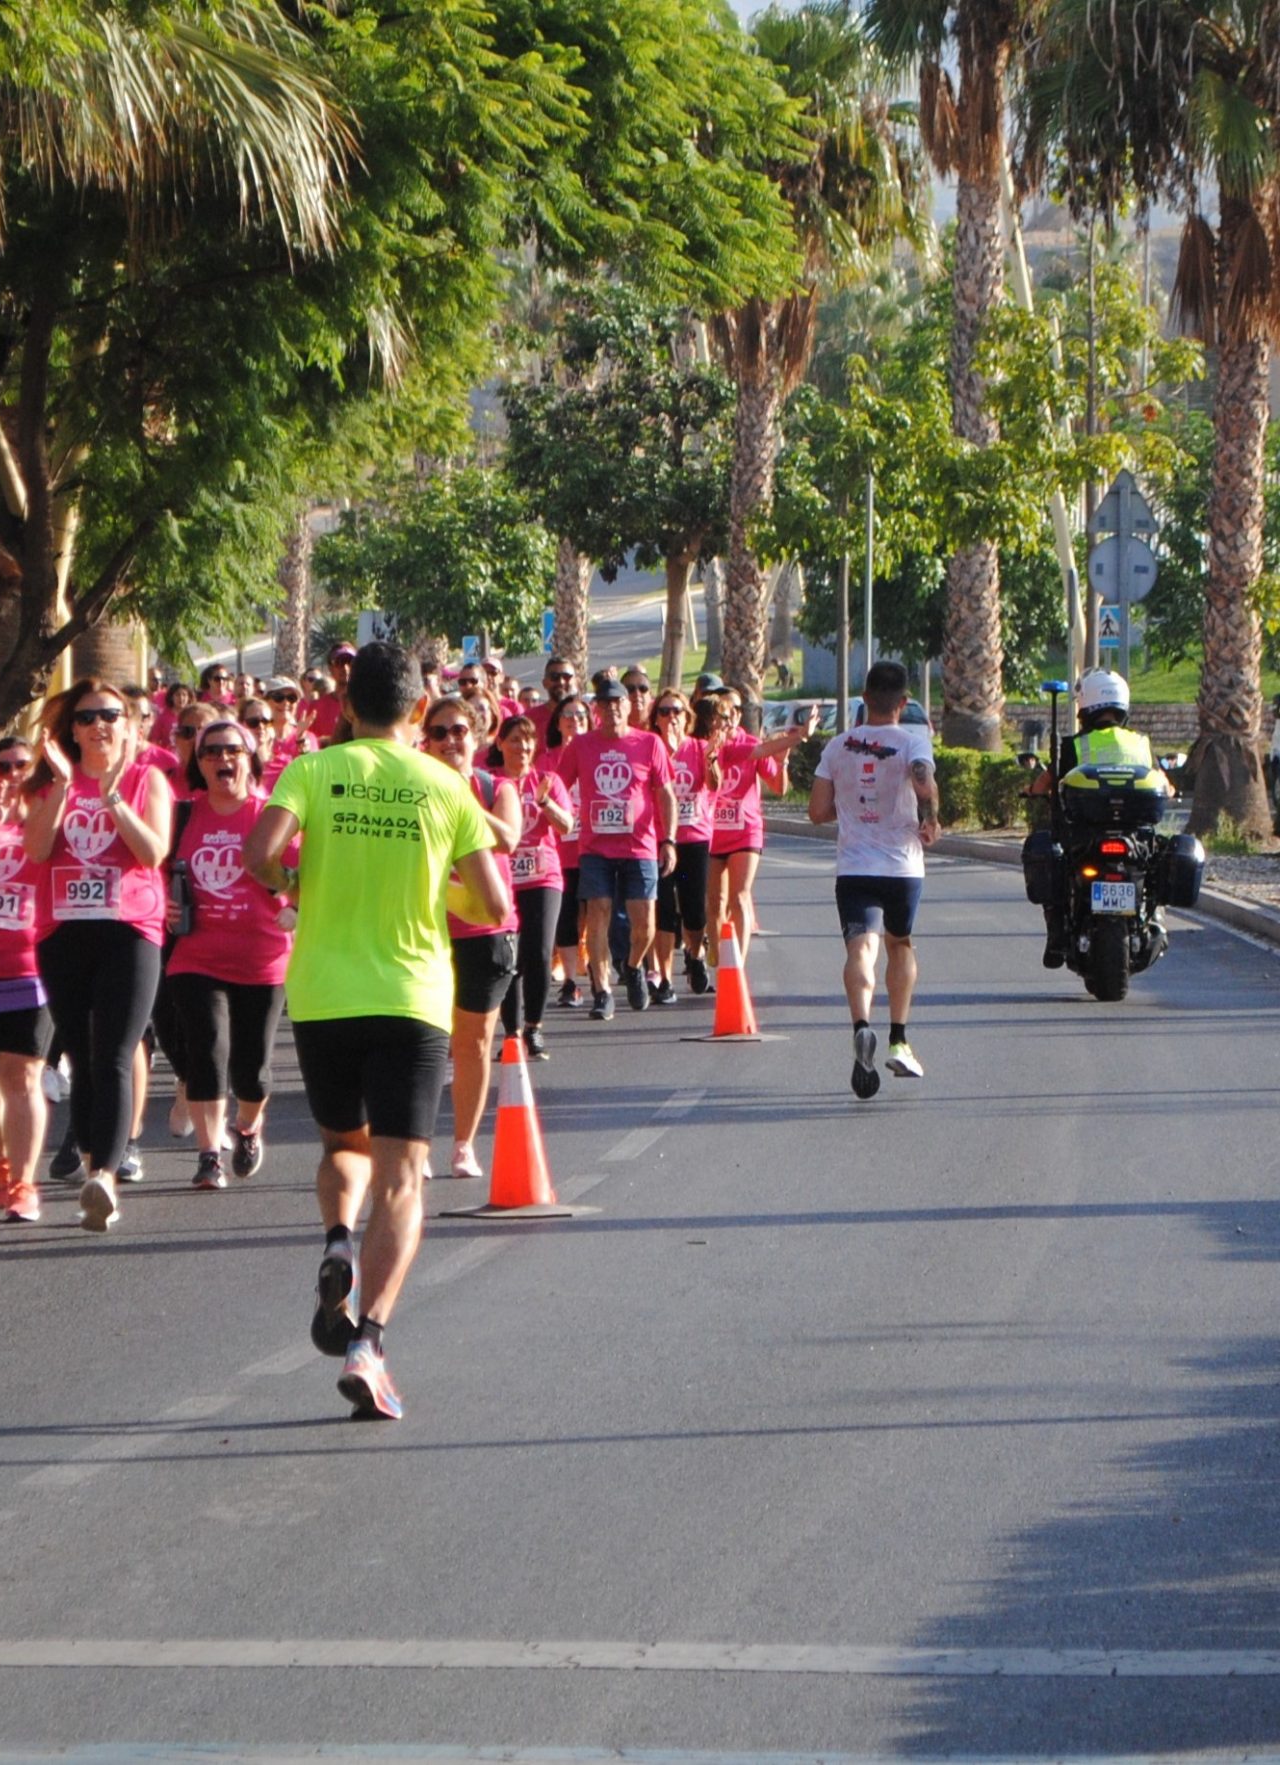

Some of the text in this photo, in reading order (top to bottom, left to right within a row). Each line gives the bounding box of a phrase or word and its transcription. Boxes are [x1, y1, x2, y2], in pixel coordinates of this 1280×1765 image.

[333, 812, 420, 831] GRANADA
[600, 810, 624, 822] 192
[332, 825, 421, 842] RUNNERS
[509, 859, 534, 872] 248
[67, 881, 104, 900] 992
[1101, 884, 1134, 897] 6636
